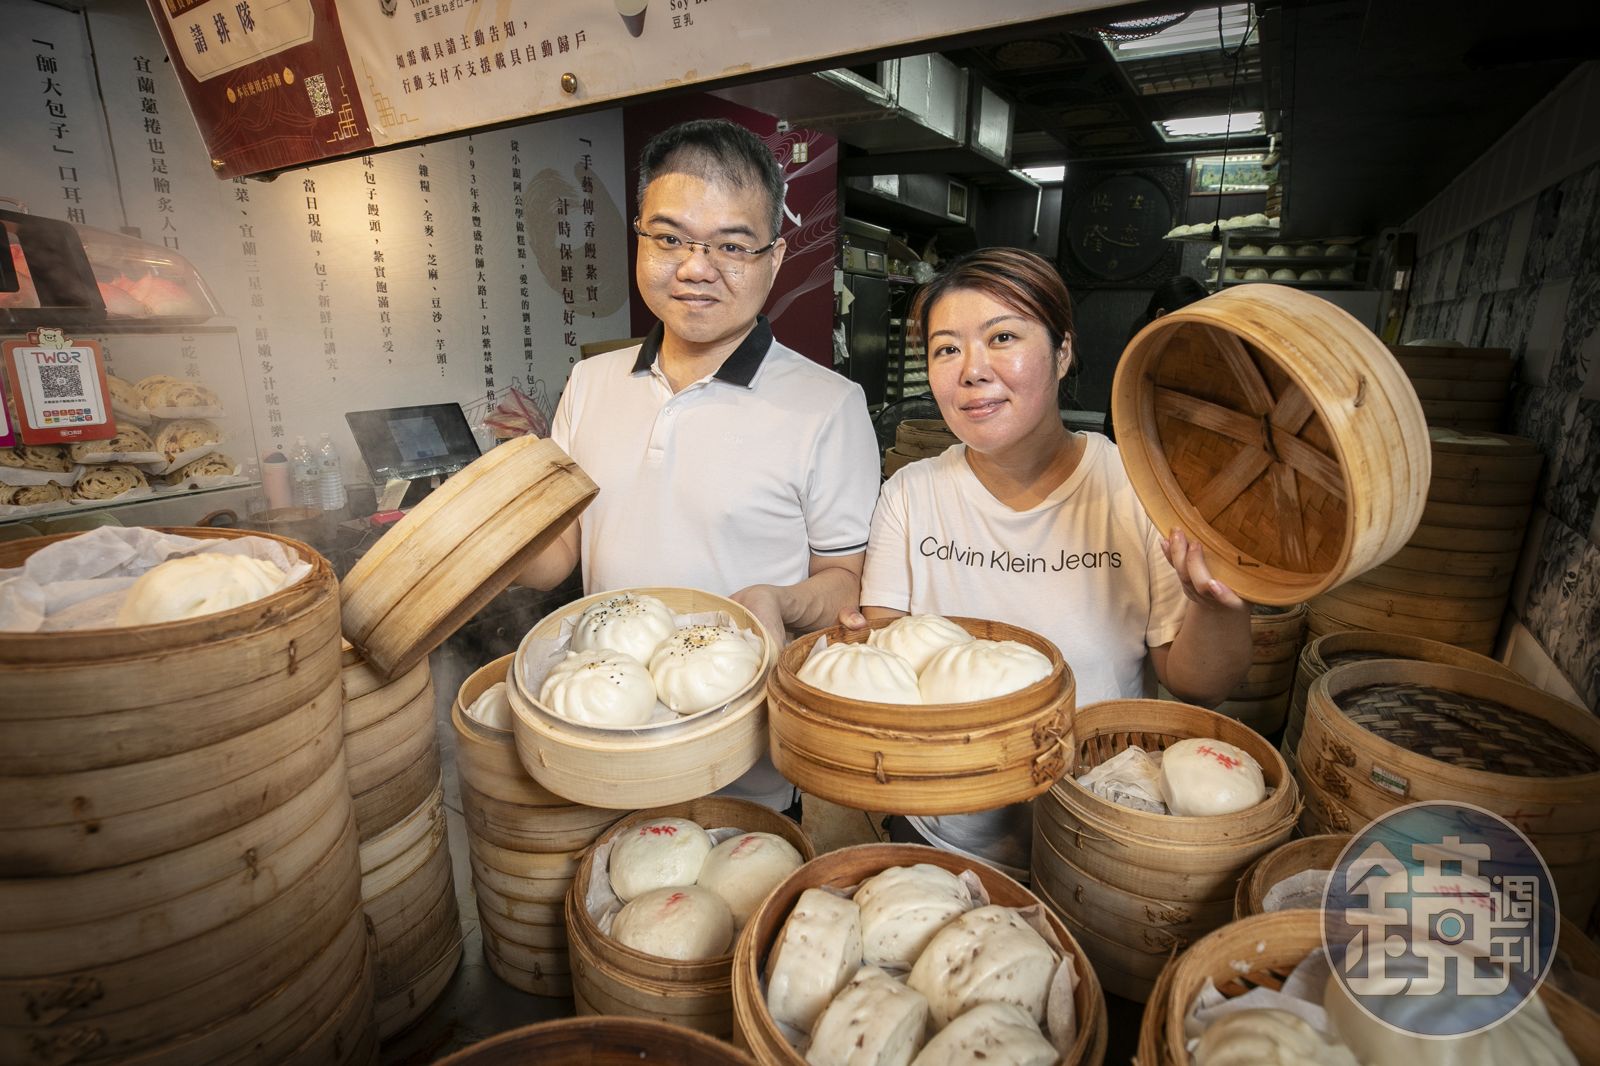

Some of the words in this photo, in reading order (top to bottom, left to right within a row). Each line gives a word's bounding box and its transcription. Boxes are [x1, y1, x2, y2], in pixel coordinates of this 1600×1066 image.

[190, 1, 255, 54] 請排隊
[672, 13, 693, 29] 豆乳
[402, 30, 586, 94] 行動支付不支援載具自動歸戶
[558, 198, 577, 383] 計時保鮮包好吃。
[30, 352, 82, 364] TWQR
[919, 536, 984, 567] Calvin
[990, 550, 1046, 573] Klein
[1051, 549, 1122, 572] Jeans
